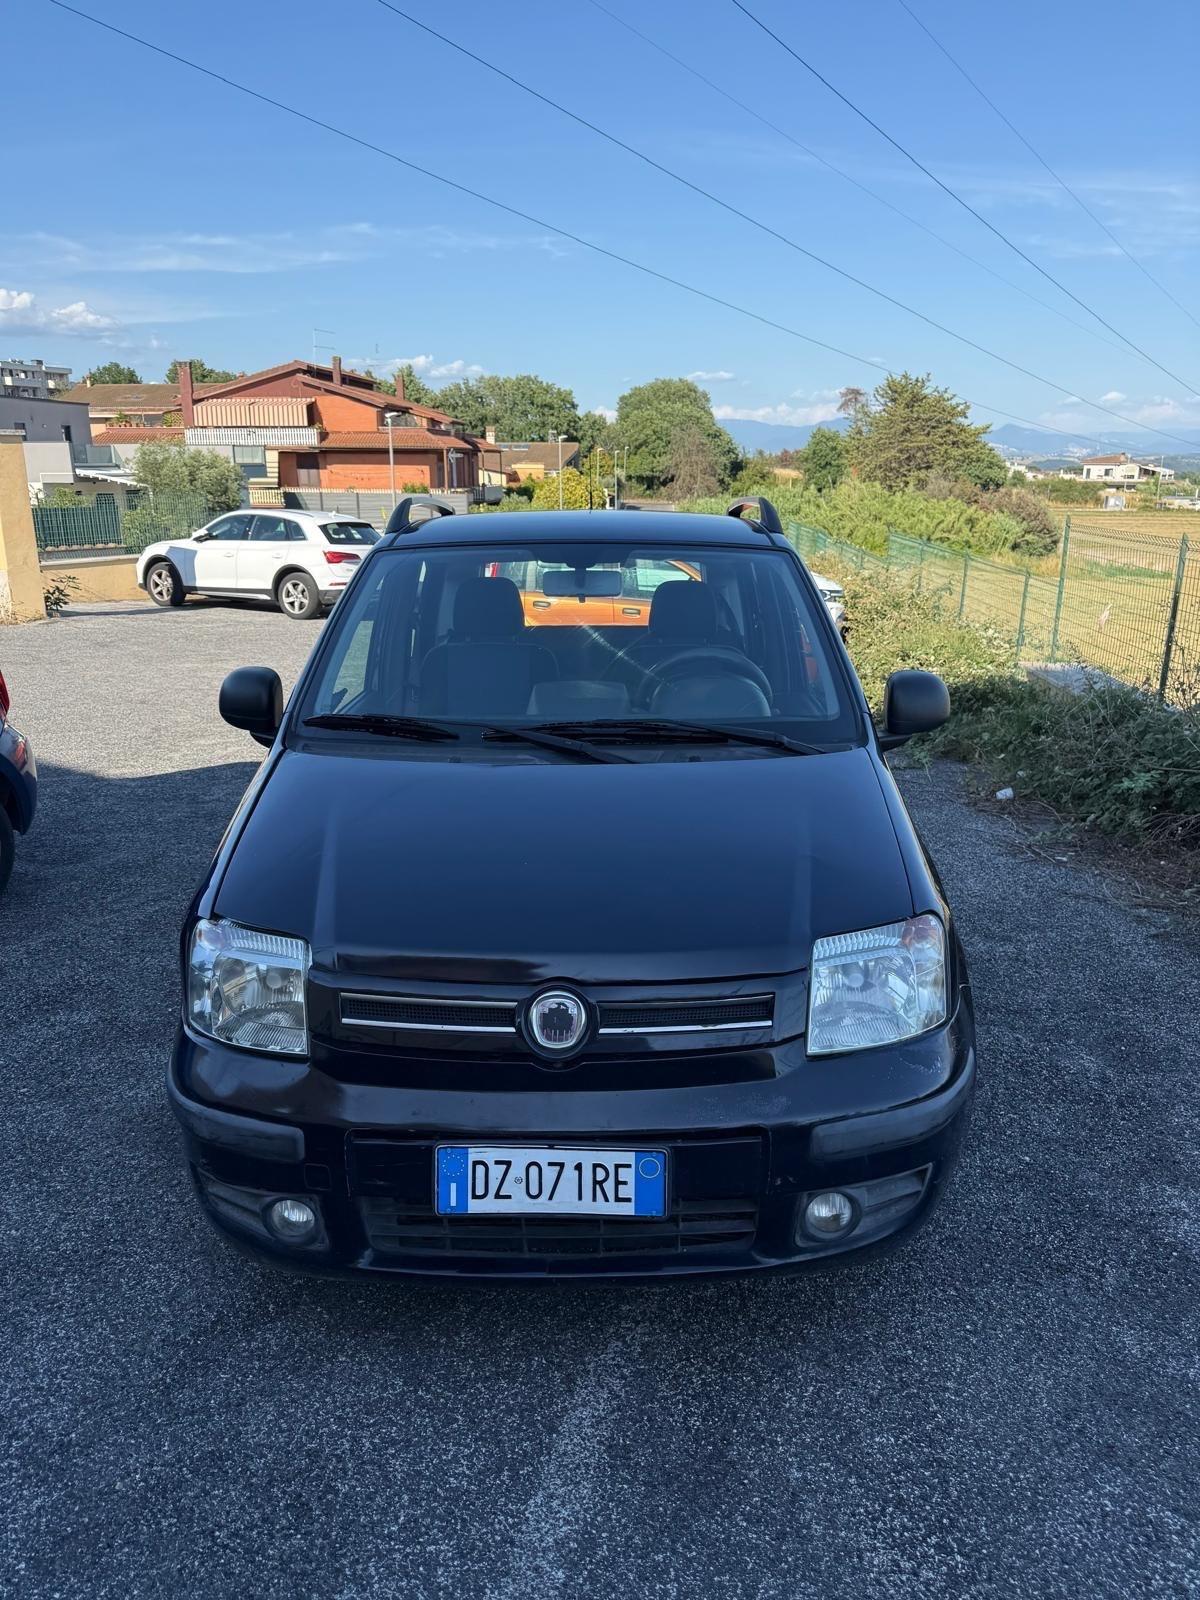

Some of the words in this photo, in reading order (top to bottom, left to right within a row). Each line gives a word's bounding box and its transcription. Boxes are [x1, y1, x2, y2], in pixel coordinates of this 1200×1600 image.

[450, 1182, 457, 1207] I
[471, 1160, 512, 1200] DZ
[525, 1161, 632, 1203] 071RE
